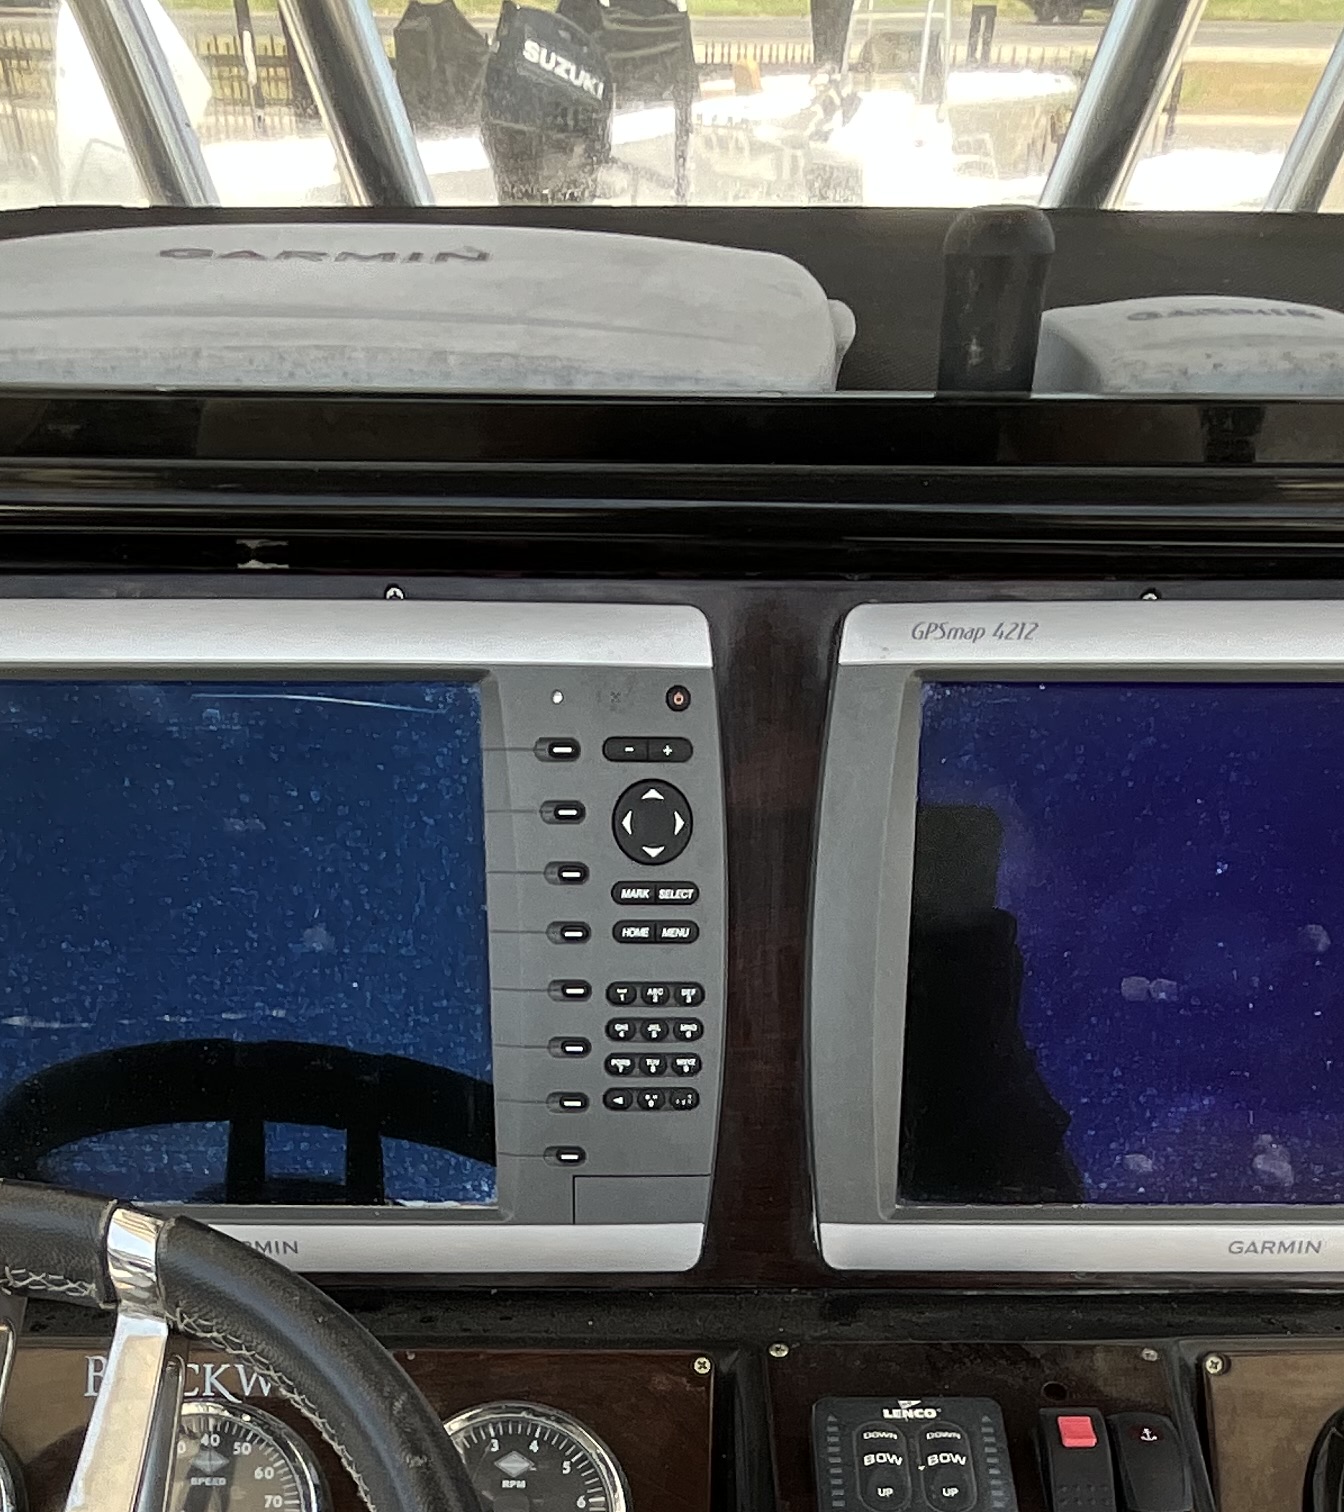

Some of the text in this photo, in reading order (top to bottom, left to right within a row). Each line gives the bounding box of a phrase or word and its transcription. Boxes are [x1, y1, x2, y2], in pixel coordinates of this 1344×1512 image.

[523, 39, 604, 100] SUZUKI
[159, 247, 490, 263] GARMIN
[911, 621, 1039, 644] GPSmap 4212
[620, 888, 695, 900] MARK SELECT
[621, 927, 690, 938] HOME MENU
[1228, 1240, 1322, 1254] GARMIN
[882, 1408, 938, 1420] LENCO
[200, 1433, 220, 1447] 40
[863, 1431, 898, 1440] DOWN
[926, 1431, 962, 1440] DOWN
[233, 1441, 252, 1456] 50
[490, 1439, 500, 1452] 3
[529, 1439, 539, 1453] 4
[863, 1452, 903, 1466] BOW
[927, 1452, 967, 1466] BOW
[254, 1466, 274, 1480] 60
[562, 1460, 572, 1475] 5
[190, 1477, 227, 1486] SPEED
[501, 1479, 527, 1489] RPM
[877, 1487, 894, 1498] UP
[942, 1487, 960, 1497] UP
[264, 1494, 283, 1508] 70
[576, 1494, 587, 1509] 6
